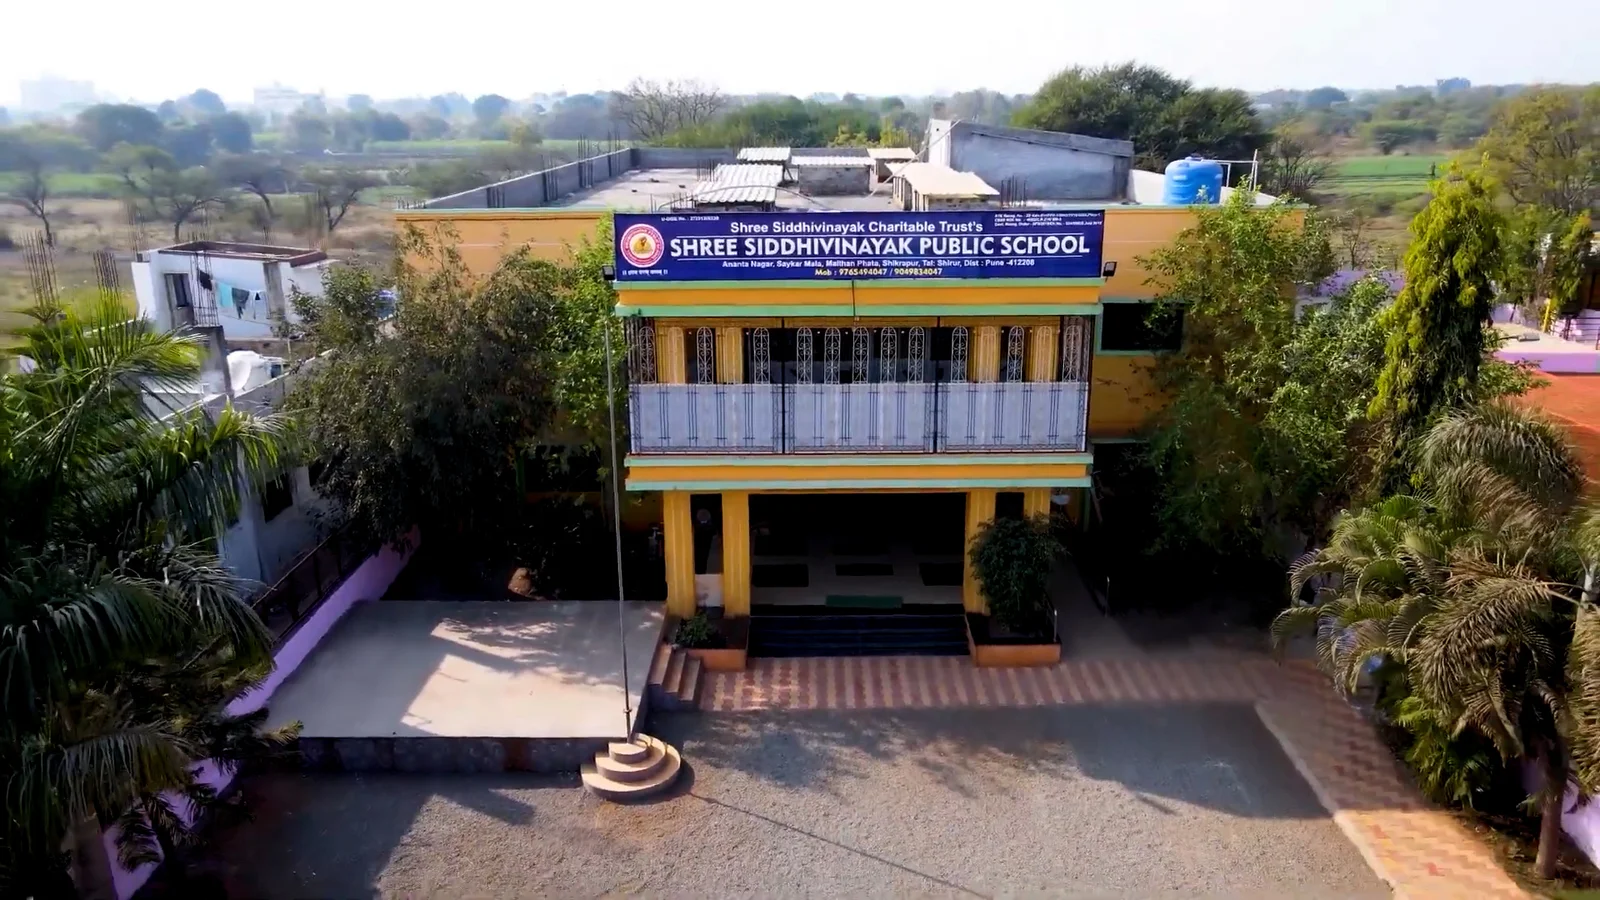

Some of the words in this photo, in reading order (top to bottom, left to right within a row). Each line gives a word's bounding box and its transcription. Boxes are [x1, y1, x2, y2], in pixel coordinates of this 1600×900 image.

[730, 221, 769, 233] Shree
[773, 220, 865, 235] Siddhivinayak
[868, 221, 936, 232] Charitable
[939, 221, 984, 232] Trust's
[670, 238, 738, 257] SHREE
[744, 237, 914, 256] SIDDHIVINAYAK
[920, 237, 995, 255] PUBLIC
[1001, 236, 1091, 255] SCHOOL
[722, 260, 749, 268] Ananta
[857, 260, 881, 268] Phata,
[882, 259, 921, 268] Shikrapur,
[937, 259, 962, 268] Shirur,
[964, 259, 979, 267] Dist
[815, 268, 832, 276] Mob
[838, 268, 888, 276] 9765494047
[894, 268, 943, 276] 9049834047
